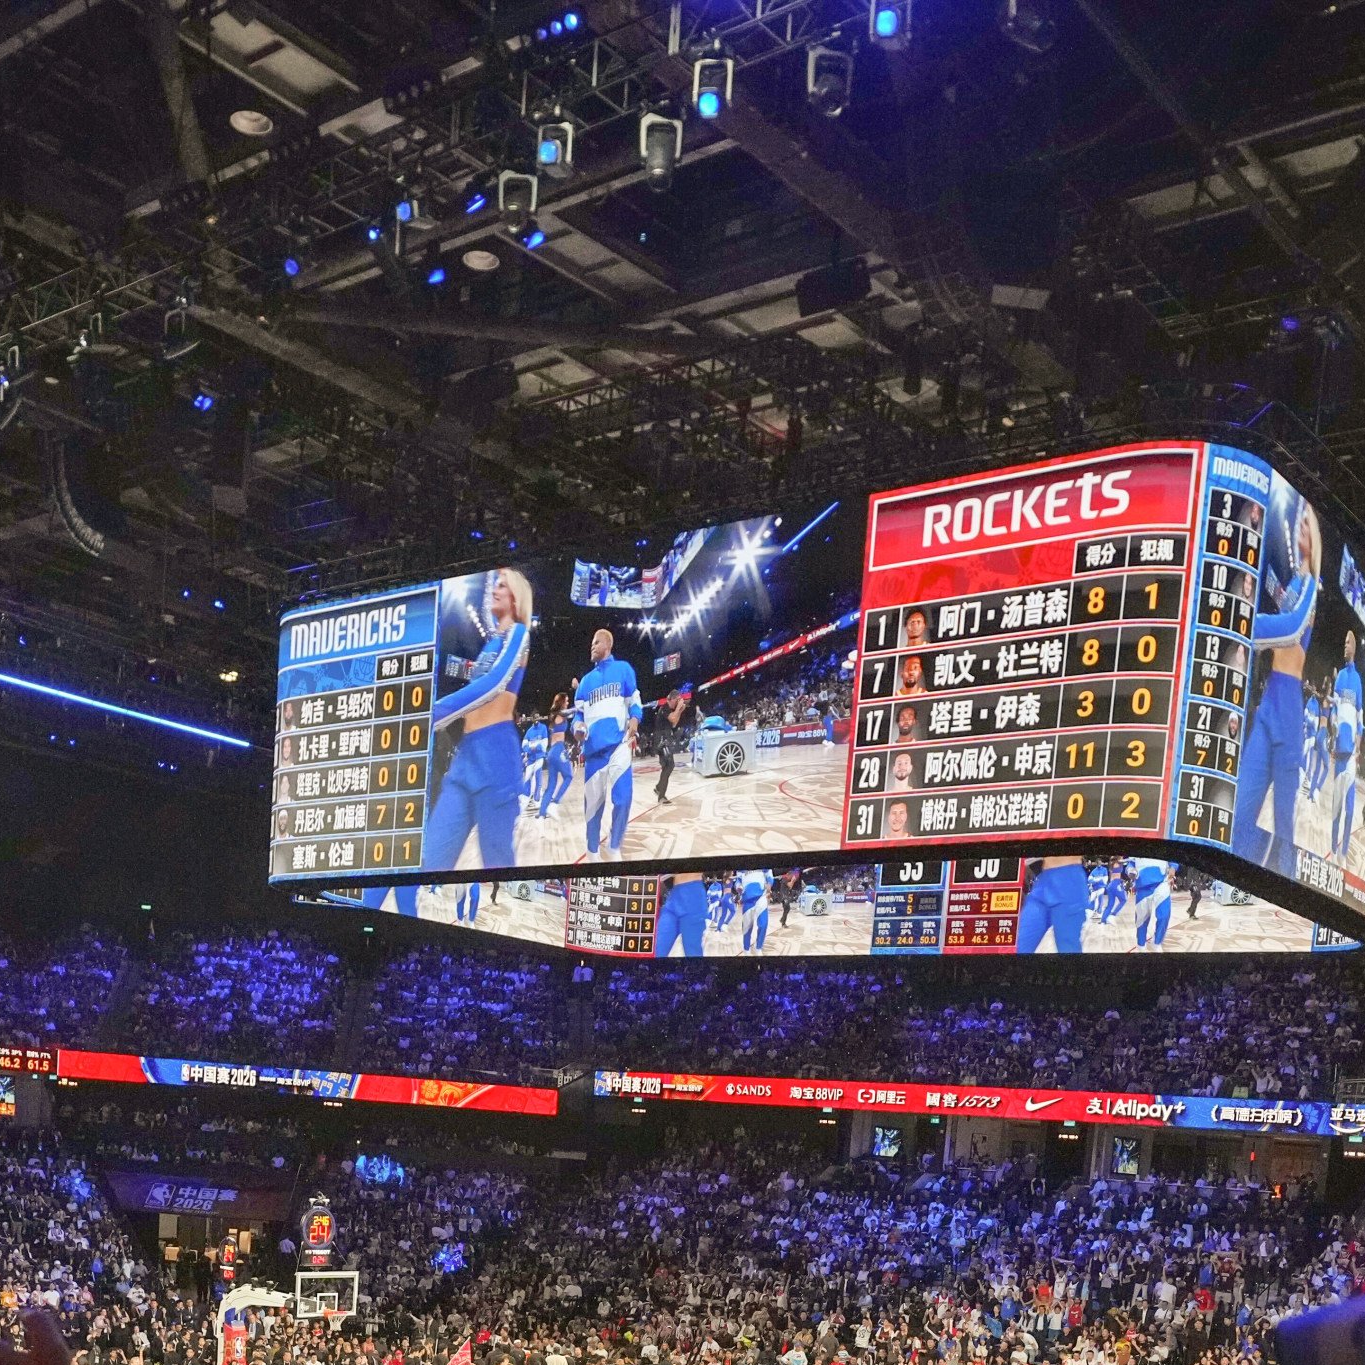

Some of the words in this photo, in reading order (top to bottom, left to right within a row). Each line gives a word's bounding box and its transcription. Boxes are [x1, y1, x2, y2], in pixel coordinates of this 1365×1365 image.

[1222, 493, 1232, 519] 3
[1086, 543, 1116, 567] 得分
[1140, 539, 1174, 561] 犯规
[1218, 538, 1228, 555] 0
[1247, 549, 1255, 565] 0
[1212, 564, 1227, 590] 10
[878, 614, 887, 646] 1
[938, 588, 1069, 639] 阿门·汤普森
[1087, 586, 1105, 614] 8
[1145, 582, 1159, 610] 1
[1211, 610, 1221, 626] 0
[1240, 619, 1247, 635] 0
[290, 604, 406, 660] MAVERICKS
[1205, 635, 1220, 660] 13
[381, 659, 399, 677] 得分
[873, 662, 884, 694] 7
[933, 639, 1063, 686] 凯文·杜兰特
[1082, 638, 1099, 666] 8
[1137, 635, 1157, 663] 0
[383, 690, 393, 711] 0
[412, 686, 422, 707] 0
[1203, 680, 1214, 696] 0
[1233, 689, 1240, 704] 0
[866, 710, 884, 742] 17
[929, 694, 1041, 735] 塔里·伊森
[1077, 690, 1095, 717] 3
[1132, 688, 1152, 715] 0
[1197, 706, 1211, 730] 21
[381, 729, 391, 749] 0
[410, 725, 420, 745] 0
[858, 757, 881, 789] 28
[1066, 742, 1095, 769] 11
[1126, 740, 1146, 767] 3
[1197, 750, 1206, 765] 7
[1226, 758, 1232, 774] 2
[378, 767, 388, 787] 0
[407, 764, 417, 784] 0
[1190, 775, 1205, 800] 31
[376, 805, 386, 824] 7
[404, 802, 415, 822] 2
[857, 805, 875, 835] 31
[1067, 793, 1084, 819] 0
[1121, 792, 1140, 819] 2
[1188, 820, 1199, 835] 0
[1219, 827, 1225, 841] 1
[373, 842, 383, 862] 0
[403, 840, 411, 860] 1
[875, 936, 891, 944] 30.2
[897, 936, 913, 944] 24.0
[920, 935, 936, 944] 50.0
[948, 935, 965, 944] 53.8
[972, 935, 989, 943] 46.2
[995, 935, 1013, 943] 61.5
[1318, 928, 1327, 942] 31
[27, 1060, 49, 1071] 61.5
[190, 1066, 256, 1087] 中国赛2026
[612, 1076, 661, 1094] 中国赛2026
[736, 1085, 772, 1097] SANDS
[789, 1086, 844, 1101] 淘宝88VIP
[875, 1090, 906, 1105] 阿里云
[173, 1197, 214, 1211] 2026
[178, 1186, 239, 1202] 中国赛
[309, 1225, 332, 1243] 24
[312, 1255, 327, 1264] 0:24
